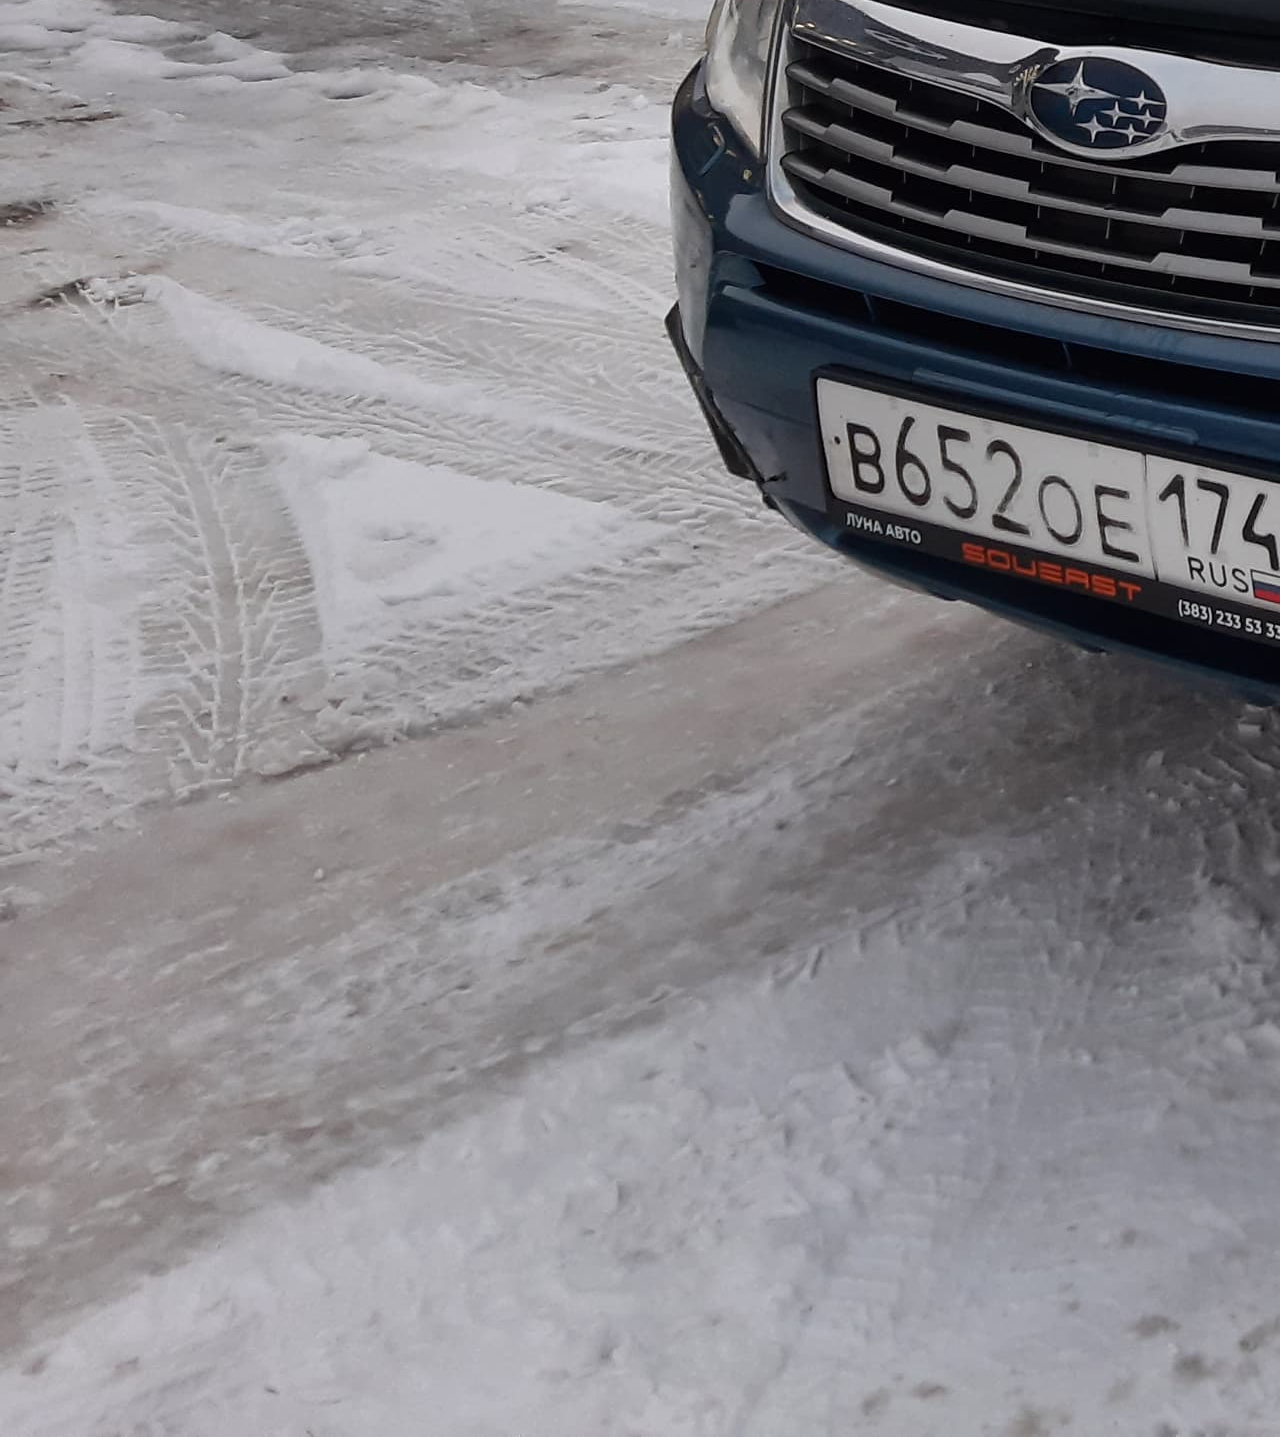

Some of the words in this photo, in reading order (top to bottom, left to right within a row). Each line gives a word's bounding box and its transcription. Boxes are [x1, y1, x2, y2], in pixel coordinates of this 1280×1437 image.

[846, 512, 884, 535] ЛУНА
[885, 524, 922, 544] АВТО
[1157, 473, 1280, 572] 174
[1187, 556, 1249, 594] RUS
[1178, 599, 1213, 625] (383)
[1215, 610, 1242, 629] 233
[1245, 617, 1263, 635] 53
